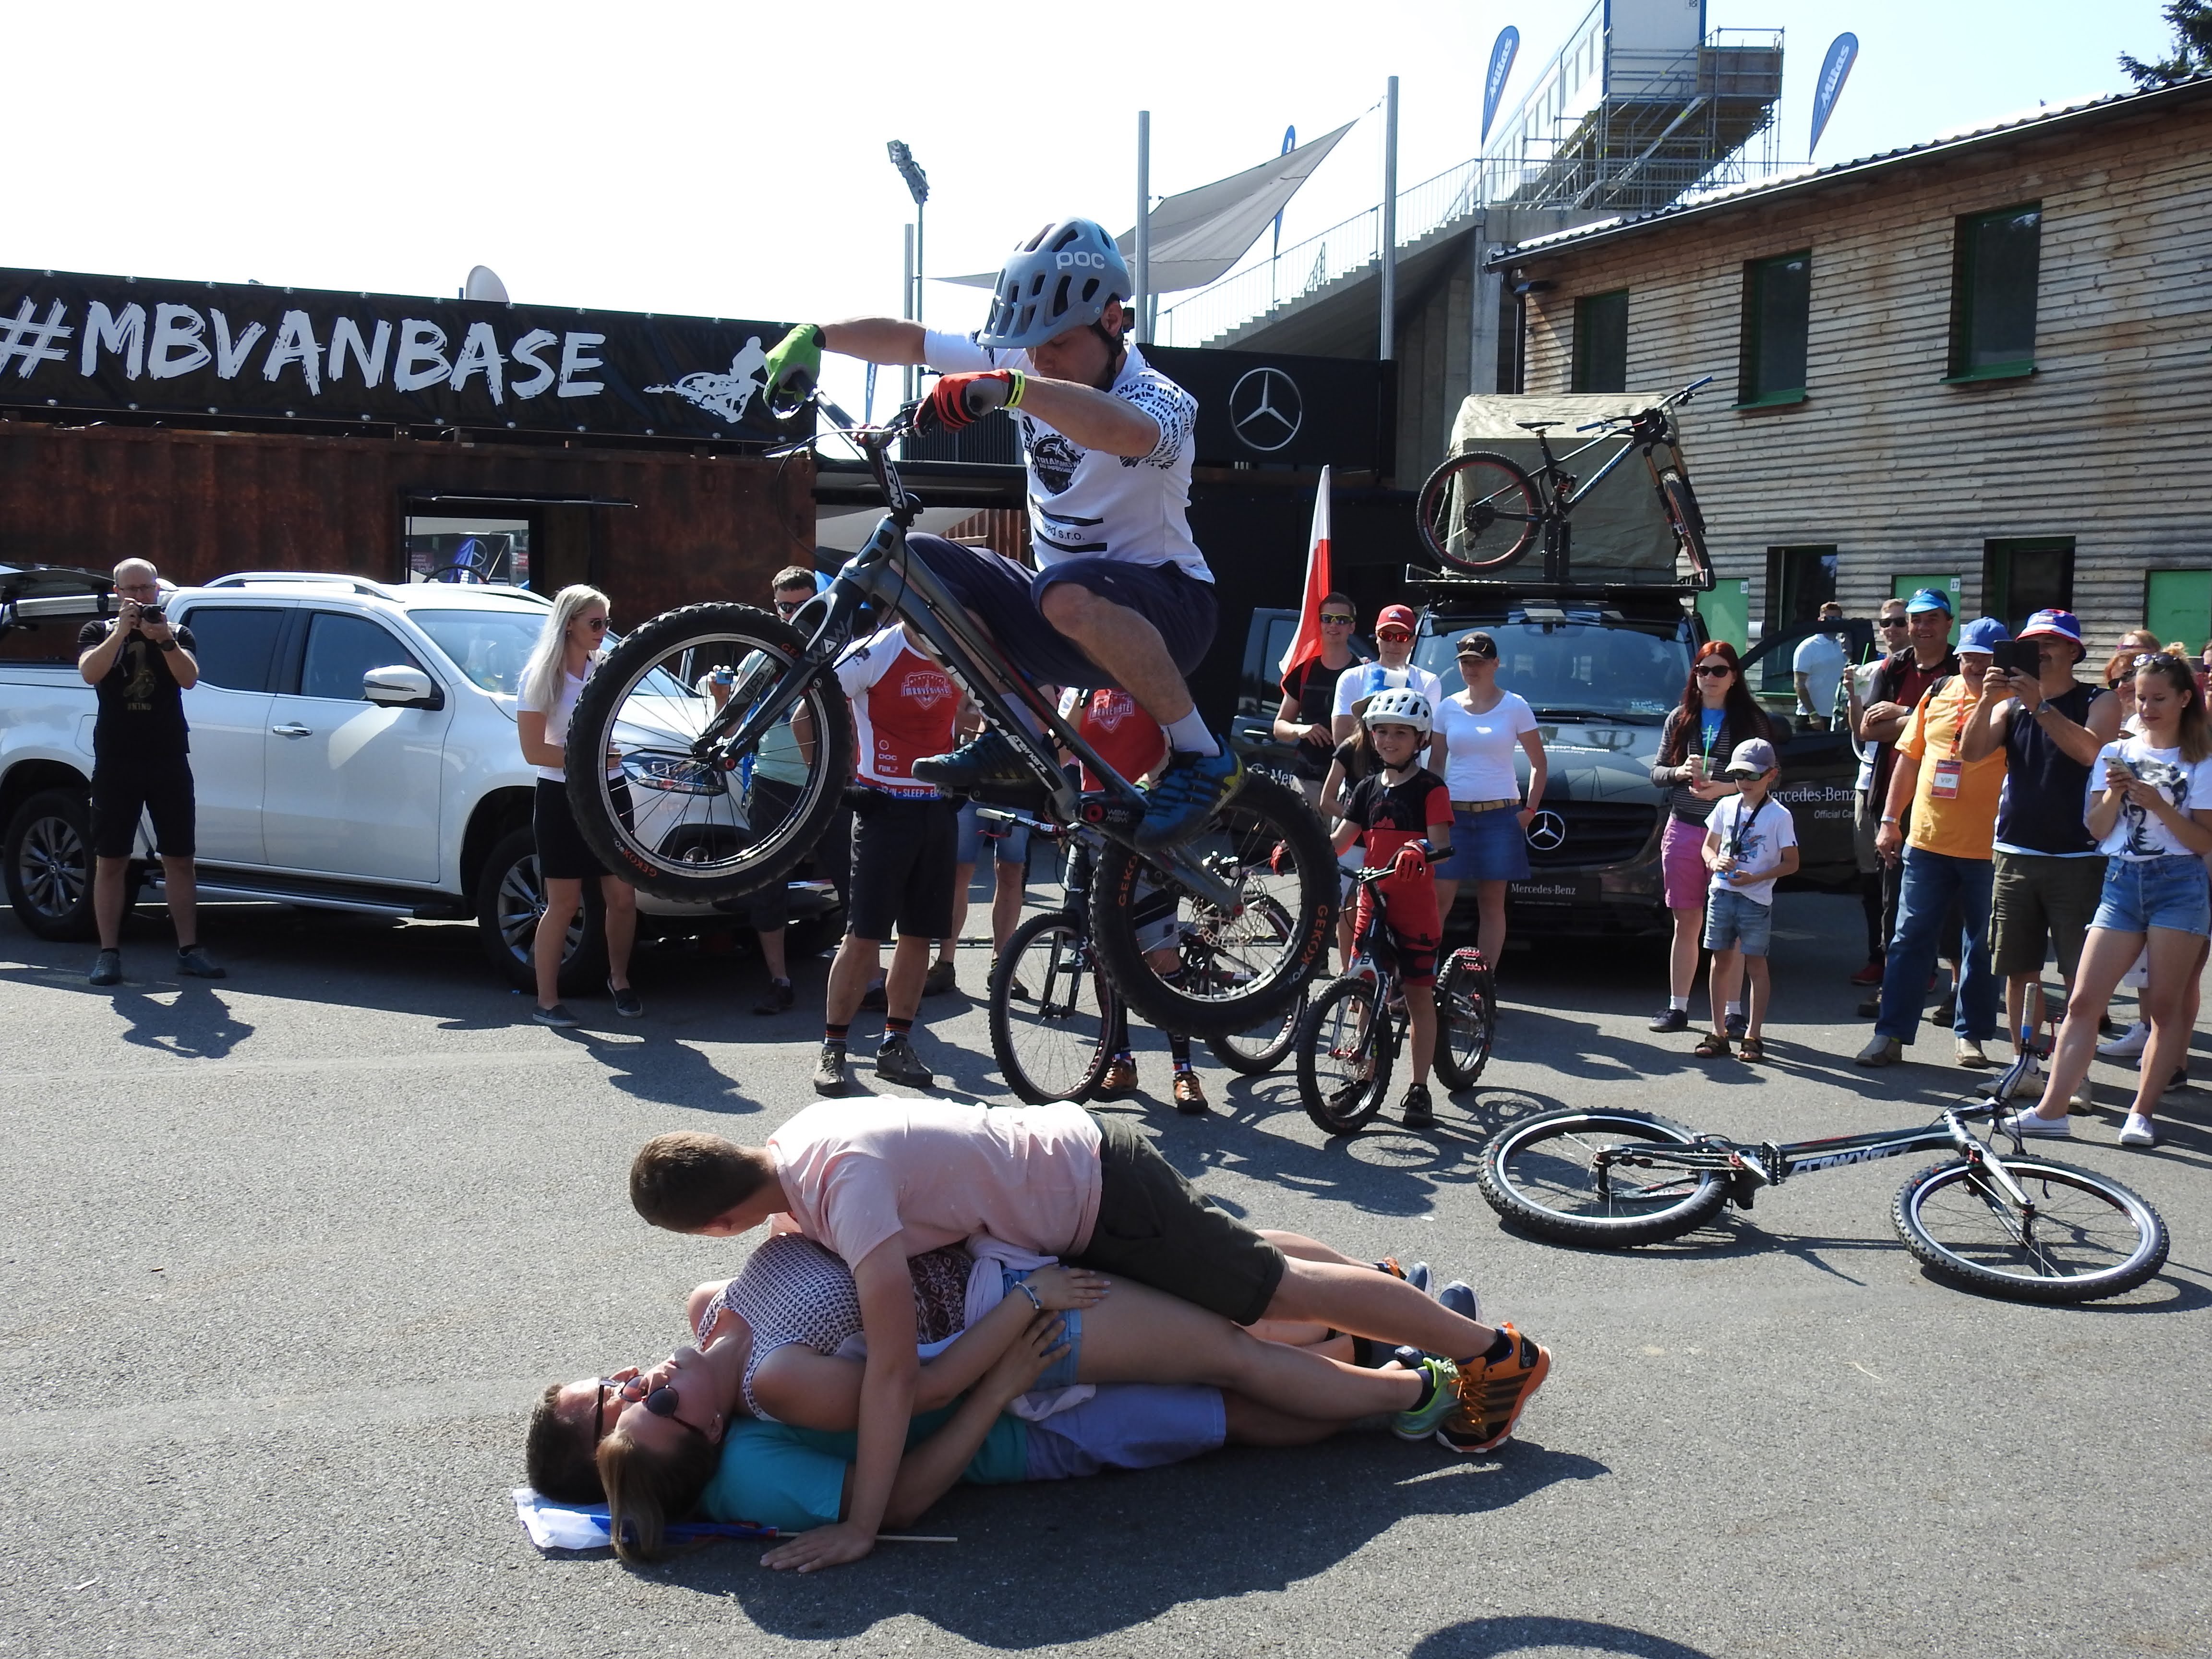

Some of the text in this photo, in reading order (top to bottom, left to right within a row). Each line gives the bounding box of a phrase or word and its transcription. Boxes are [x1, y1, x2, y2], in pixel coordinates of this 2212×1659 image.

[1490, 38, 1513, 98] Mitas
[1821, 45, 1849, 108] Mitas
[0, 295, 606, 406] #MBVANBASE
[879, 448, 902, 509] CLEAN
[903, 788, 925, 798] SLEEP
[1769, 786, 1856, 802] ercedes-Benz
[1814, 810, 1840, 819] Official
[1511, 882, 1576, 895] Mercedes-Benz
